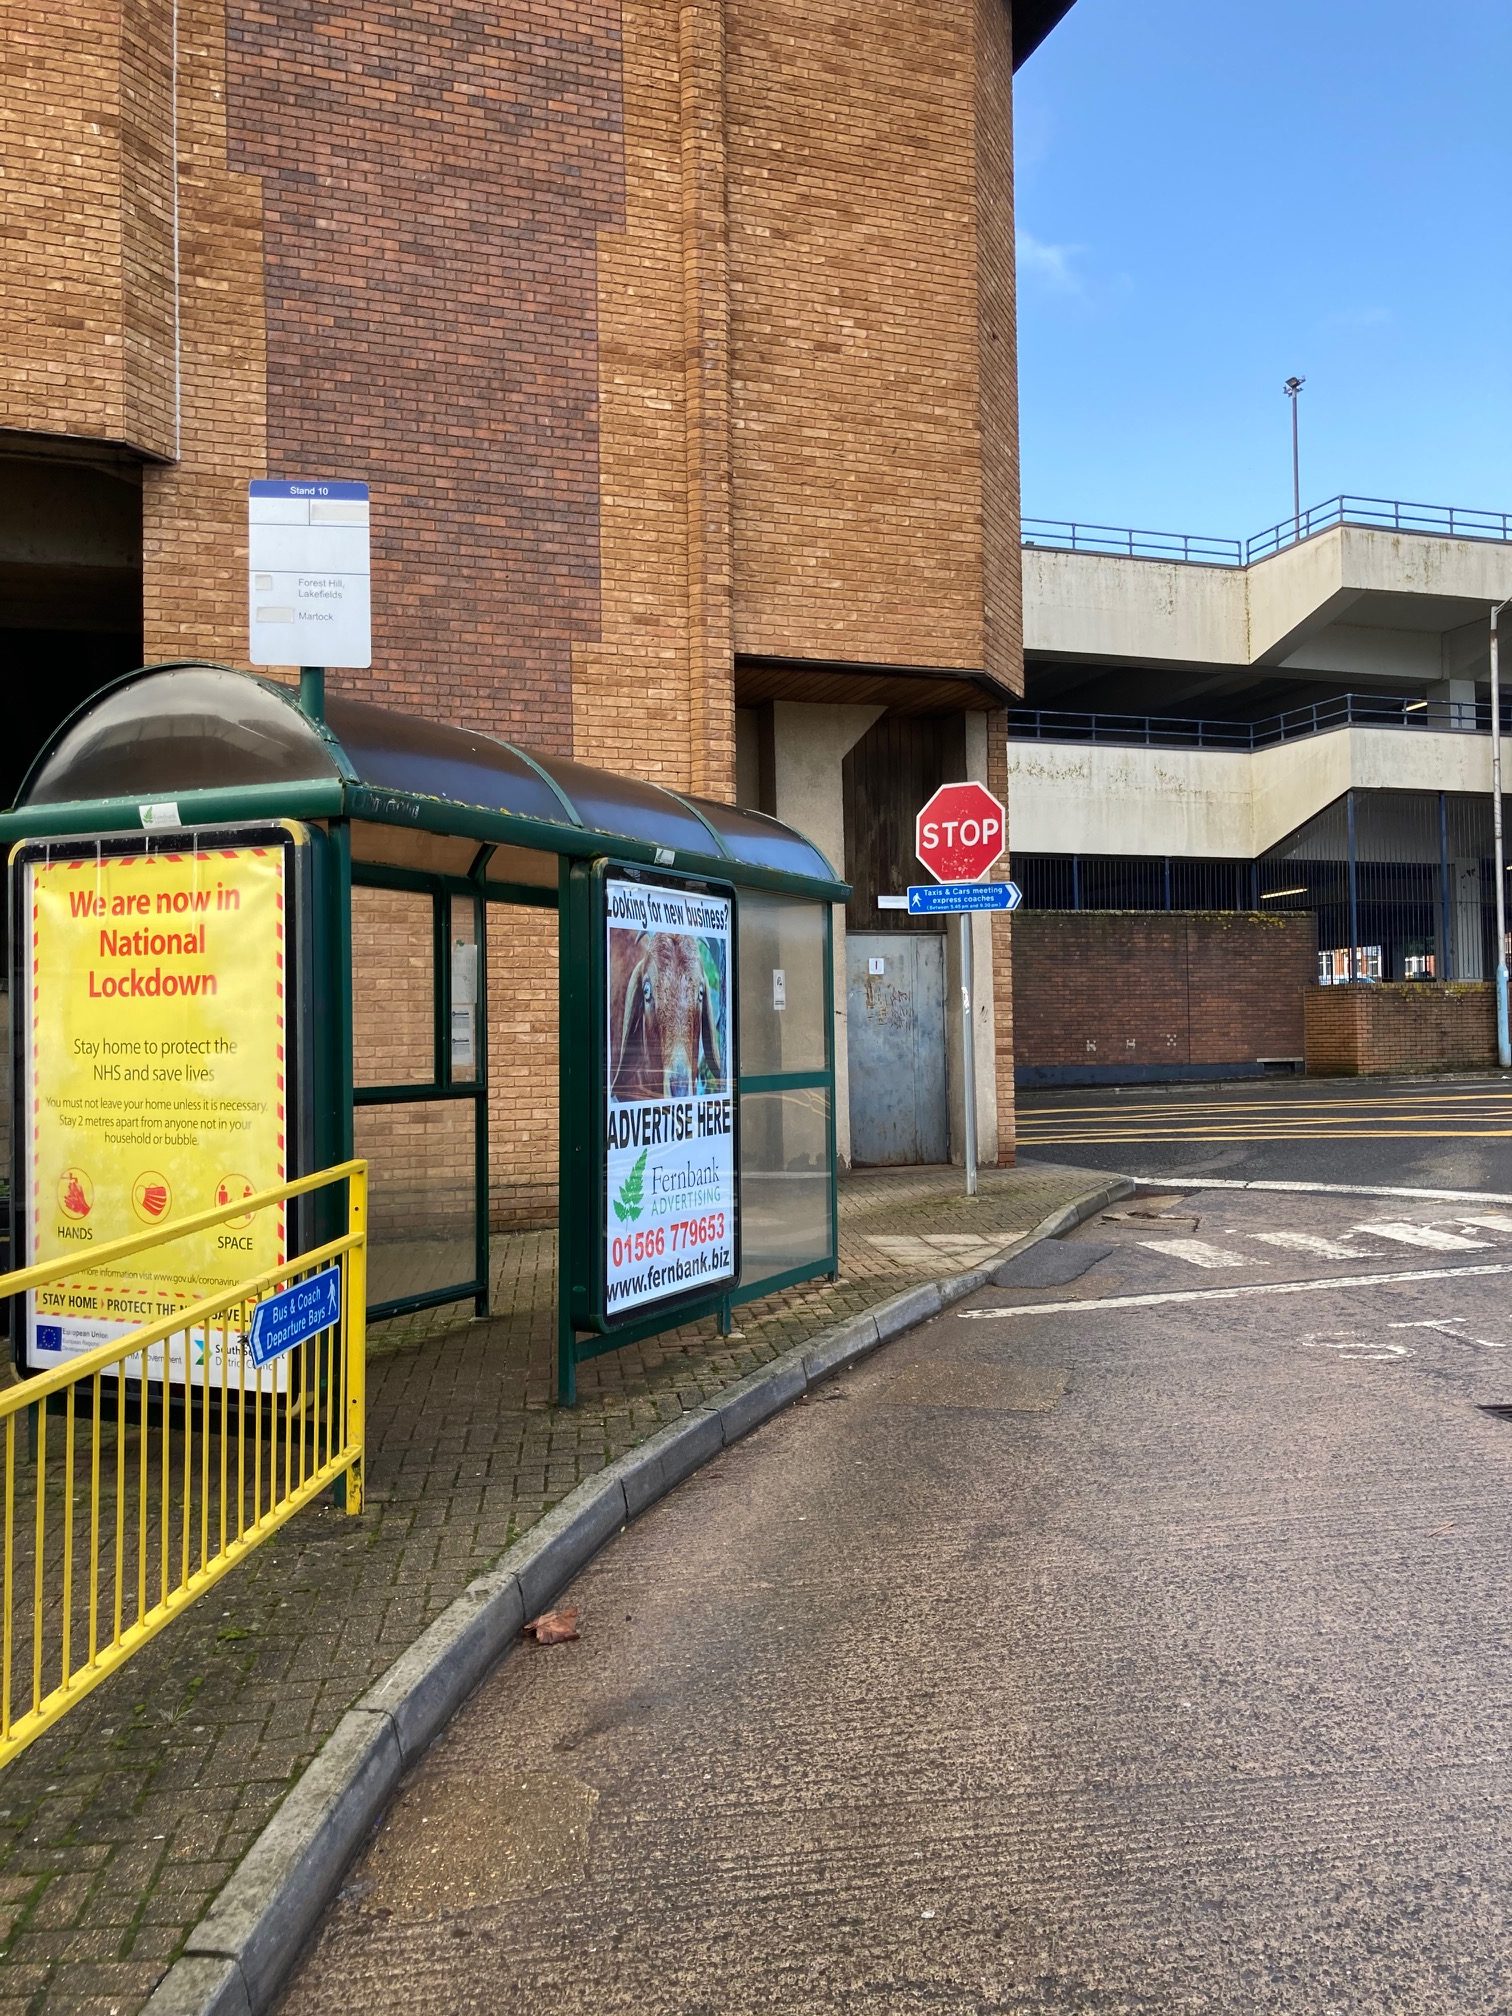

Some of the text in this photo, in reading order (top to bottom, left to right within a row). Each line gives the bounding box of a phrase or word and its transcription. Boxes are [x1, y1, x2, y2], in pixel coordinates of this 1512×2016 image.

[290, 486, 328, 495] Stand 10
[298, 579, 345, 589] Forest Hill,
[298, 589, 342, 599] Lakefields
[298, 612, 334, 621] Martock
[922, 818, 999, 850] STOP
[69, 882, 240, 918] We are now in
[647, 893, 662, 923] for
[663, 903, 684, 925] new
[685, 899, 728, 931] business?
[100, 924, 205, 957] National
[89, 967, 217, 998] Lockdown
[74, 1037, 238, 1058] Stay home to protect the
[94, 1064, 215, 1081] NHS and save lives
[46, 1097, 268, 1114] You must not leave your home unless it is necessary.
[59, 1115, 251, 1133] Stay 2 metres apart from anyone not in your
[607, 1099, 730, 1150] ADVERTISE HERE
[104, 1132, 199, 1146] household or bubble.
[652, 1157, 720, 1195] Fernbank
[652, 1186, 720, 1216] ADVERTISING
[58, 1226, 93, 1240] HANDS
[218, 1236, 253, 1250] SPACE
[612, 1213, 725, 1267] 01566 779653
[100, 1268, 138, 1279] information
[139, 1272, 152, 1281] visit
[607, 1246, 730, 1303] www.fernbank.biz
[42, 1293, 66, 1306] STAY
[68, 1296, 98, 1309] HOME
[107, 1299, 153, 1314] PROTECT
[156, 1303, 176, 1315] THE
[273, 1305, 288, 1324] Bus
[290, 1298, 295, 1314] &
[298, 1286, 320, 1310] Coach
[91, 1329, 108, 1339] Union
[267, 1306, 325, 1350] Departure Bays
[216, 1344, 240, 1355] Suth
